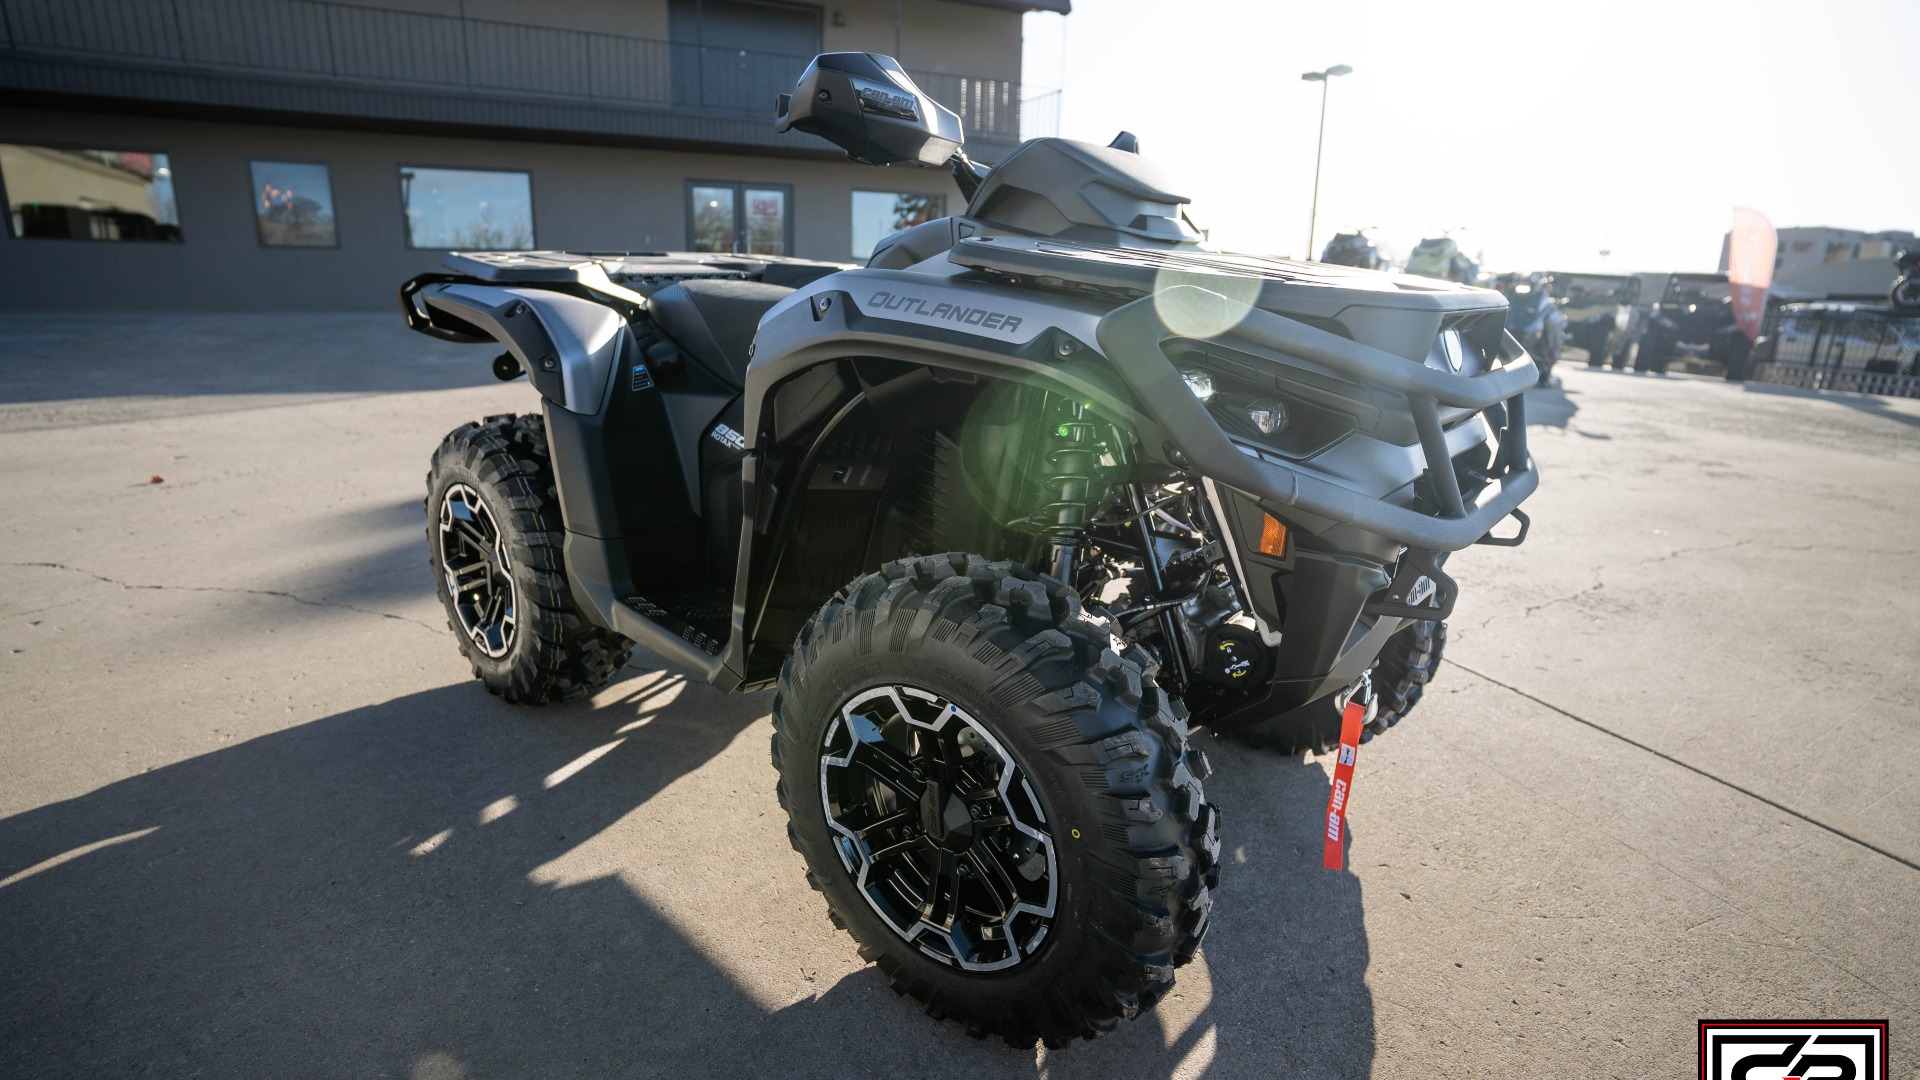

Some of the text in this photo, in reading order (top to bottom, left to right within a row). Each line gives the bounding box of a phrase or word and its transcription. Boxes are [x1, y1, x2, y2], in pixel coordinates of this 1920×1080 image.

[861, 87, 914, 111] can-am
[867, 291, 1023, 333] OUTLANDER
[711, 431, 732, 448] ROTAX
[1328, 779, 1347, 841] can-am
